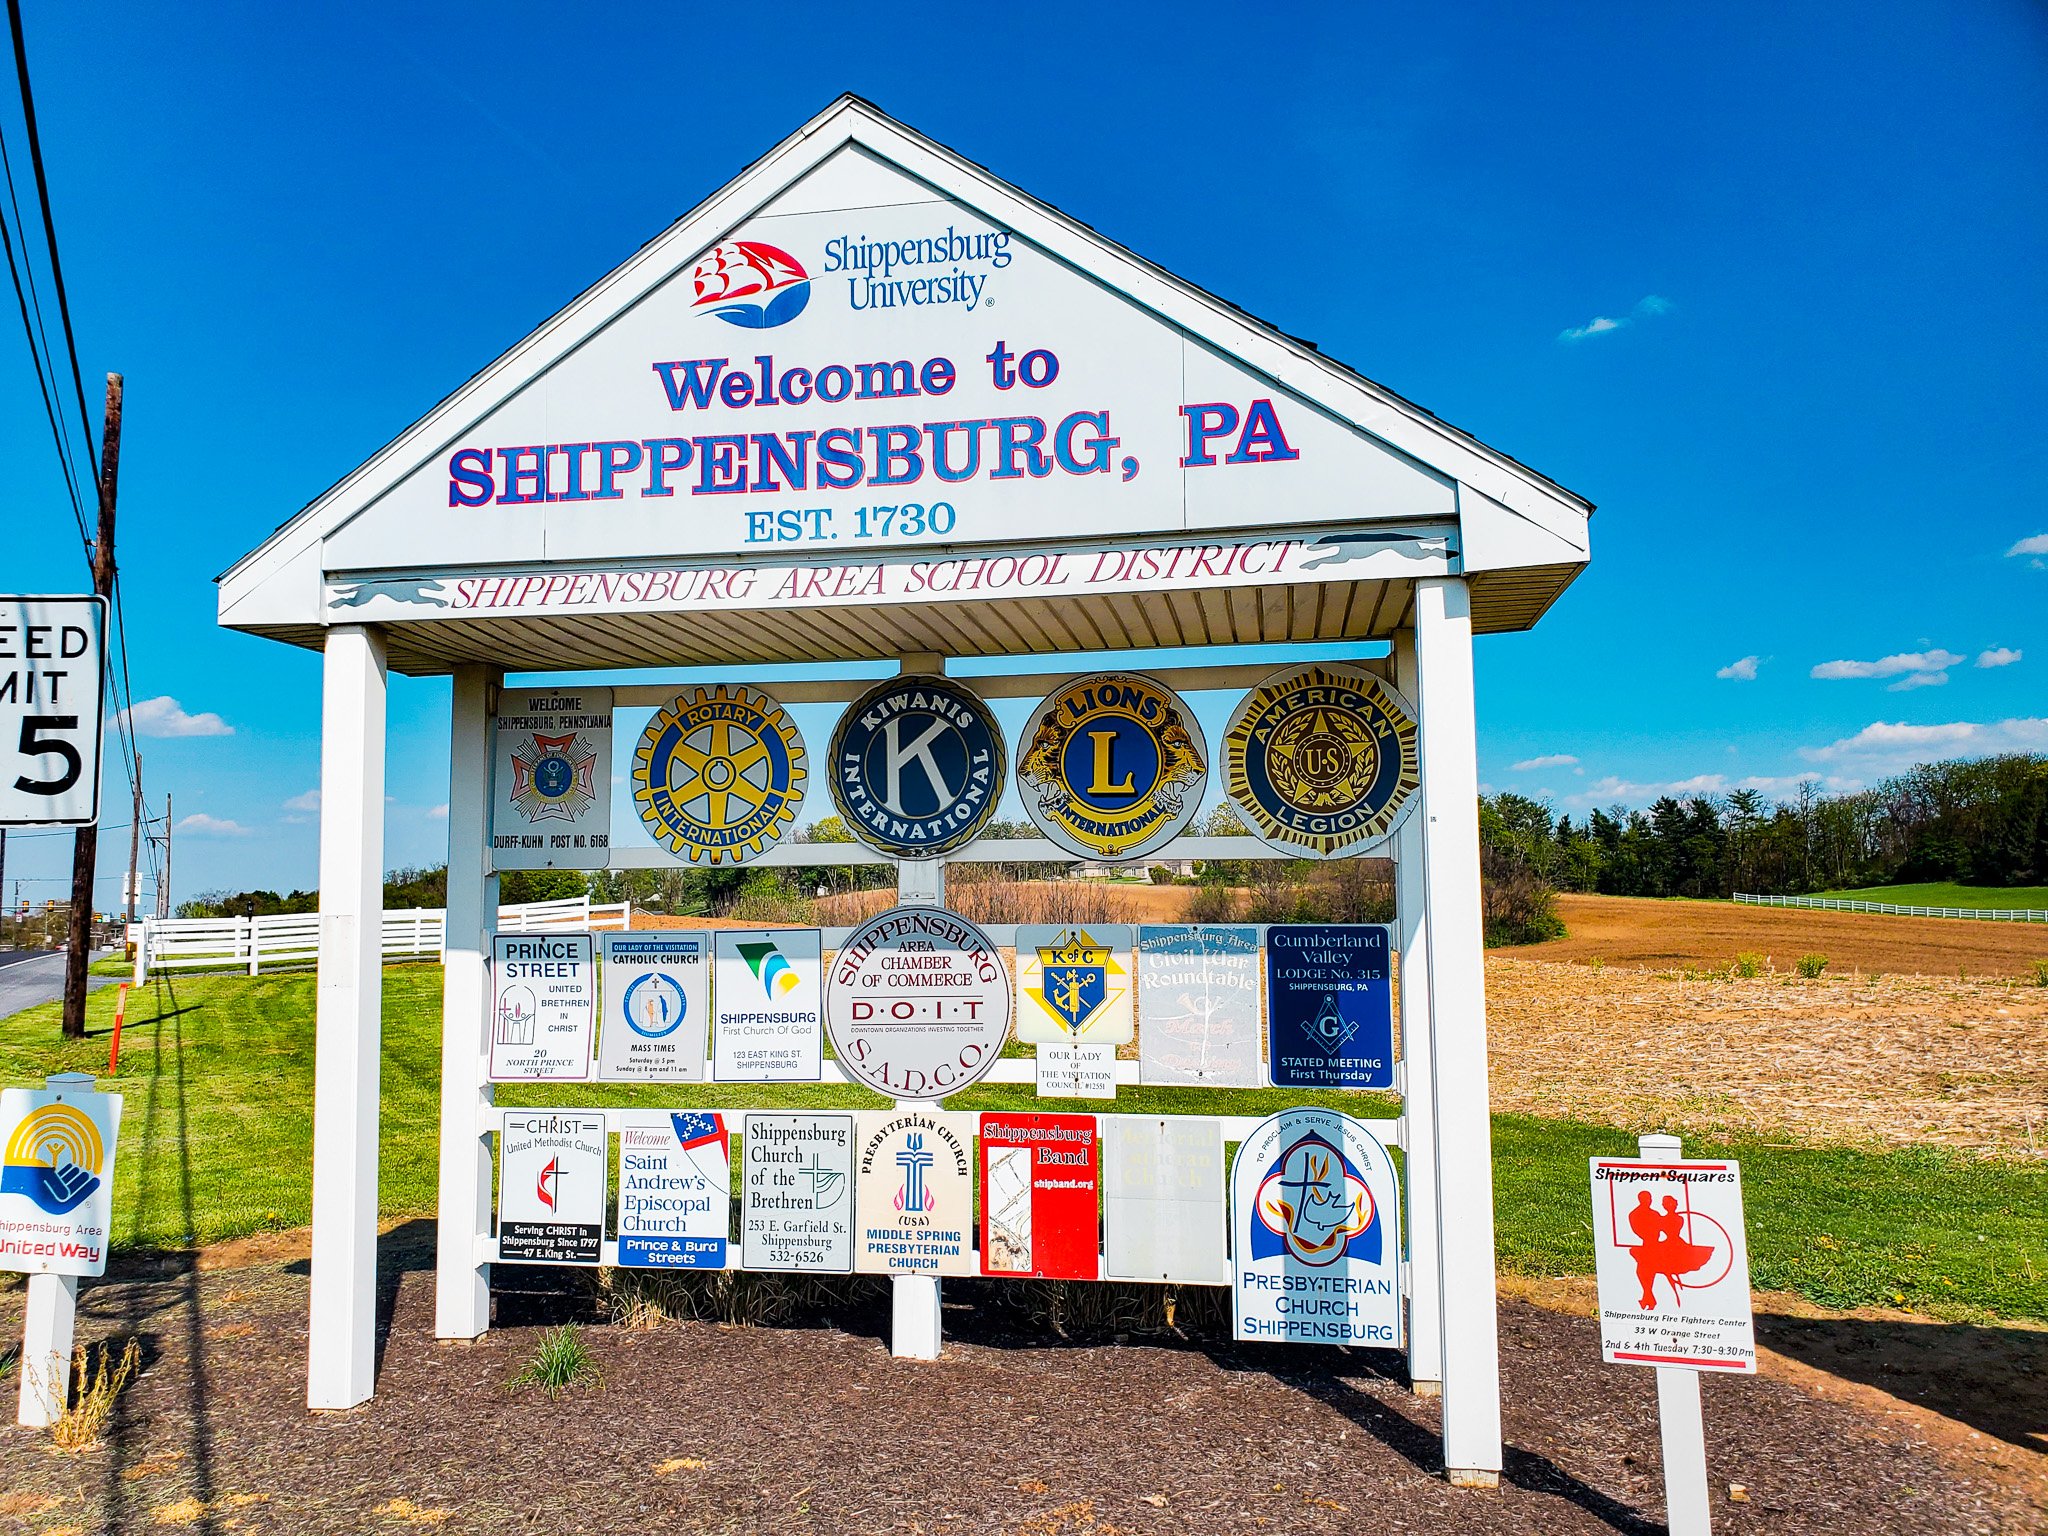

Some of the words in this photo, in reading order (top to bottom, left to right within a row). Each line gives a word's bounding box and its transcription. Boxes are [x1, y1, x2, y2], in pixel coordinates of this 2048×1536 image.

[823, 227, 1012, 279] Shippensburg
[849, 270, 986, 312] University
[654, 356, 956, 411] Welcome
[987, 342, 1059, 388] to
[449, 411, 1140, 507] SHIPPENSBURG,
[1180, 400, 1300, 467] PA
[744, 511, 838, 544] EST.
[854, 503, 956, 538] 1730
[450, 570, 756, 610] SHIPPENSBURG
[772, 565, 887, 600] AREA
[903, 552, 1070, 593] SCHOOL
[1083, 541, 1304, 584] DISTRICT
[529, 698, 582, 711] WELCOME
[1063, 685, 1161, 719] LIONS
[687, 704, 757, 726] ROTARY
[860, 692, 973, 731] KIWANIS
[1255, 689, 1392, 744] AMERICAN
[498, 717, 556, 730] SHIPPENSBURG,
[559, 715, 611, 729] PENNSYLVANIA
[13, 716, 82, 795] 5
[1087, 732, 1136, 794] L
[883, 717, 957, 816] K
[845, 749, 989, 839] INTERNATIONAL
[656, 797, 779, 845] INTERNATIONAL
[1057, 802, 1166, 836] INTERNATIONAL
[1276, 802, 1374, 832] LEGION
[494, 836, 543, 848] DURFF-KUHN
[551, 835, 570, 848] POST
[574, 835, 587, 848] NO.
[590, 835, 608, 848] 6168
[898, 941, 935, 952] AREA
[1275, 934, 1380, 947] Cumberland
[507, 943, 578, 959] PRINCE
[838, 916, 997, 986] SHIPPENSBURG
[1302, 951, 1352, 966] Valley
[613, 955, 658, 964] CATHOLIC
[661, 955, 698, 964] CHURCH
[881, 957, 952, 970] CHAMBER
[1150, 949, 1194, 968] Civil
[1203, 949, 1249, 969] War
[507, 963, 580, 978] STREET
[1277, 969, 1326, 979] LODGE
[1331, 970, 1352, 979] No.
[1358, 970, 1380, 979] 315
[862, 975, 881, 987] OF
[888, 974, 972, 986] COMMERCE
[1144, 970, 1255, 989] Roundtable
[1289, 983, 1354, 992] SHIPPENSBURG,
[720, 1013, 816, 1024] SHIPPENSBURG
[723, 1027, 740, 1035] First
[744, 1026, 774, 1035] Church
[792, 1026, 812, 1034] God
[1320, 1016, 1339, 1037] G
[534, 1050, 547, 1058] 20
[1074, 1052, 1101, 1060] LADY
[737, 1061, 798, 1069] SHIPPENSBURG
[1282, 1058, 1324, 1067] STATED
[1328, 1059, 1381, 1068] MEETING
[1291, 1070, 1314, 1079] First
[1319, 1070, 1372, 1082] Thursday
[527, 1120, 581, 1134] CHRIST
[751, 1123, 846, 1146] Shippensburg
[984, 1123, 1092, 1144] Shippensburg
[625, 1131, 670, 1145] Welcome
[1262, 1121, 1292, 1150] PROCLAIM
[1305, 1117, 1331, 1126] SERVE
[1333, 1124, 1356, 1142] JESUS
[1356, 1144, 1372, 1171] CHRIST
[506, 1139, 532, 1154] United
[535, 1137, 572, 1147] Methodist
[575, 1140, 601, 1156] Church
[862, 1117, 936, 1174] PRESBYTERIAN
[937, 1126, 967, 1176] CHURCH
[625, 1155, 667, 1169] Saint
[751, 1146, 803, 1163] Church
[1038, 1147, 1088, 1165] Band
[625, 1175, 705, 1190] Andrew's
[751, 1168, 767, 1185] of
[774, 1168, 795, 1186] the
[1595, 1168, 1660, 1182] Shippen
[1667, 1170, 1735, 1184] Squares
[1034, 1179, 1093, 1190] shipband.org
[624, 1195, 710, 1215] Episcopal
[751, 1192, 813, 1209] Brethren
[624, 1216, 686, 1232] Church
[749, 1220, 765, 1231] 253
[784, 1221, 828, 1233] Garfield
[833, 1222, 846, 1233] St.
[898, 1216, 929, 1226] (USA)
[76, 1225, 102, 1235] Area
[515, 1225, 543, 1235] Serving
[546, 1227, 577, 1236] CHRIST
[867, 1229, 912, 1240] MIDDLE
[917, 1231, 961, 1241] SPRING
[503, 1236, 555, 1247] Shippensburg
[558, 1238, 577, 1246] Since
[580, 1239, 598, 1247] 1797
[627, 1240, 668, 1250] Prince
[686, 1242, 717, 1252] Burd
[762, 1234, 832, 1250] Shippensburg
[868, 1243, 959, 1255] PRESBYTERIAN
[60, 1243, 100, 1262] Way
[523, 1249, 533, 1257] 47
[648, 1253, 695, 1263] Streets
[770, 1251, 823, 1262] 532-6526
[889, 1257, 938, 1268] CHURCH
[1604, 1311, 1658, 1321] Shippensburg
[1681, 1316, 1715, 1325] Fighters
[1718, 1319, 1746, 1327] Center
[1661, 1329, 1690, 1338] Orange
[1605, 1341, 1620, 1349] 2nd
[1634, 1342, 1650, 1351] 4th
[1654, 1343, 1688, 1354] Tuesday
